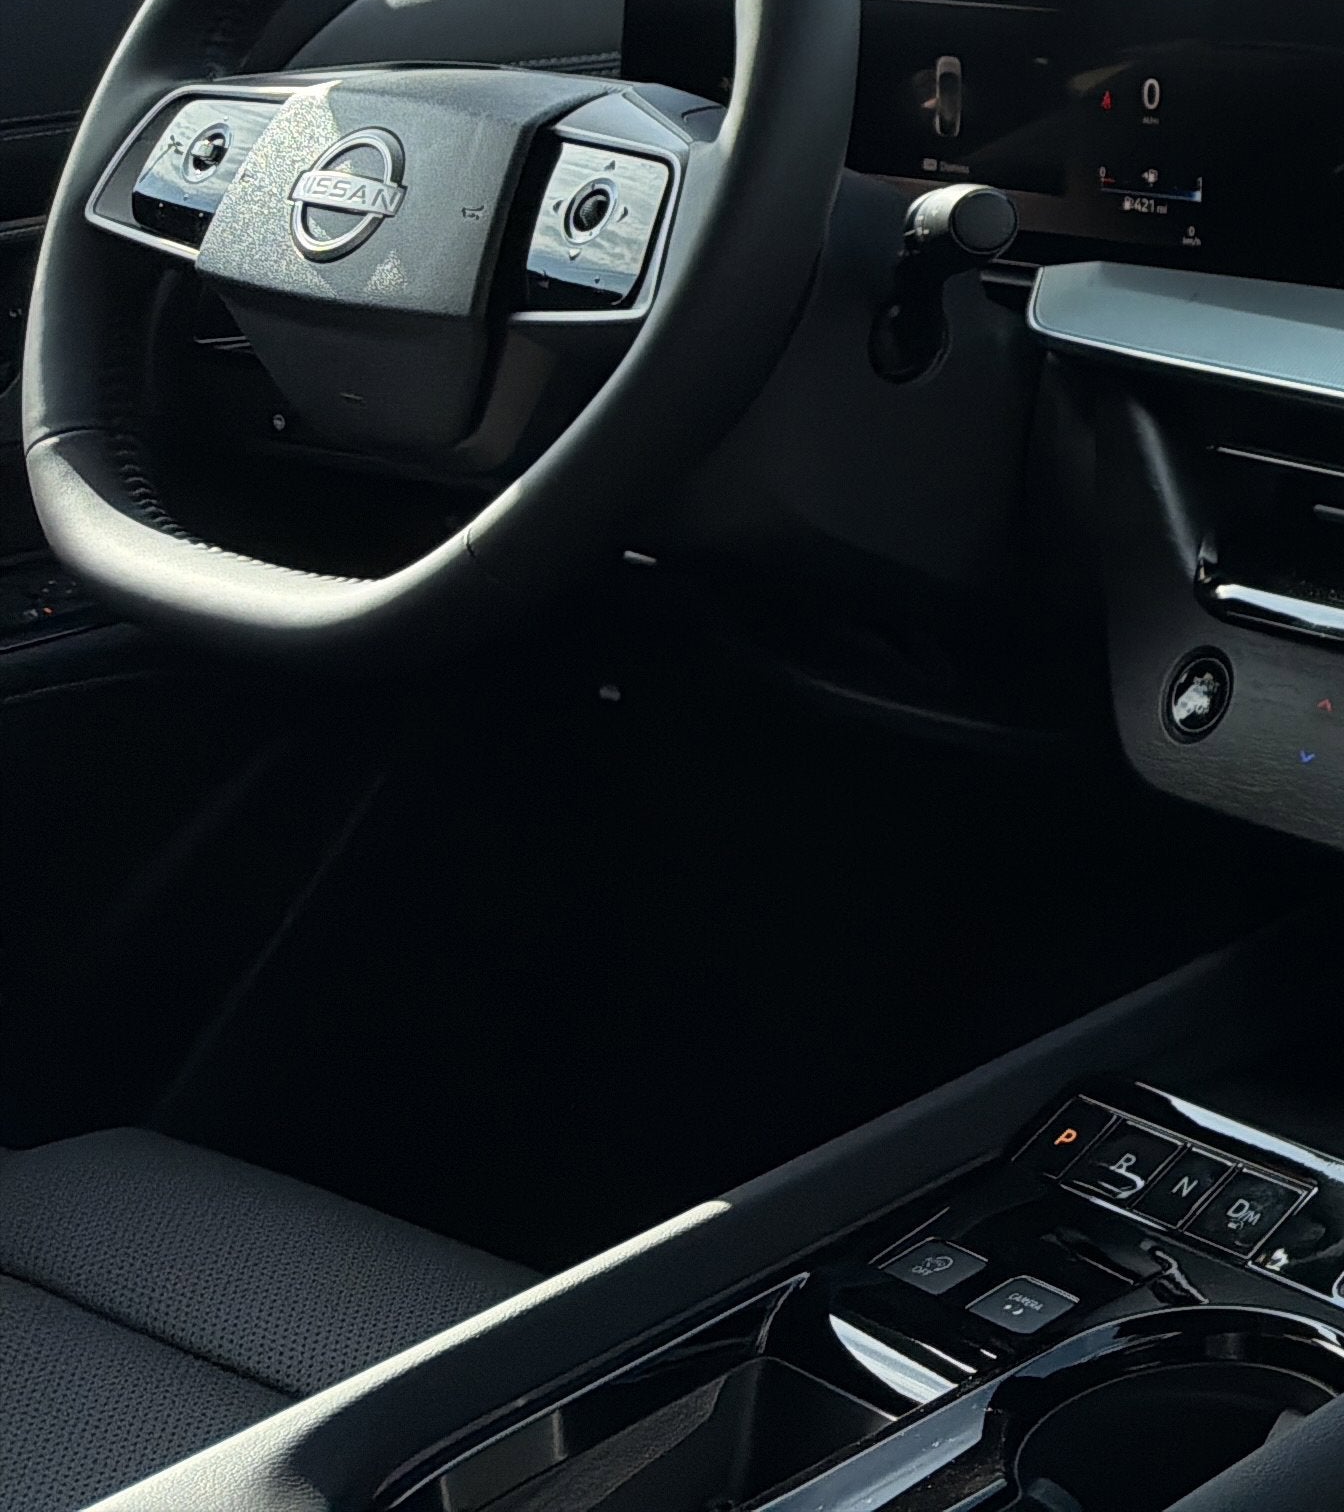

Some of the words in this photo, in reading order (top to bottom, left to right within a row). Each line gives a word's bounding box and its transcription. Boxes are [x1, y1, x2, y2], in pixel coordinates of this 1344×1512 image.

[1142, 78, 1161, 110] 0
[298, 175, 399, 215] ISSAN
[1134, 198, 1155, 214] 421
[1054, 1128, 1078, 1145] P
[1110, 1153, 1136, 1170] R
[1171, 1176, 1198, 1198] N
[1008, 1292, 1044, 1311] CAMERA
